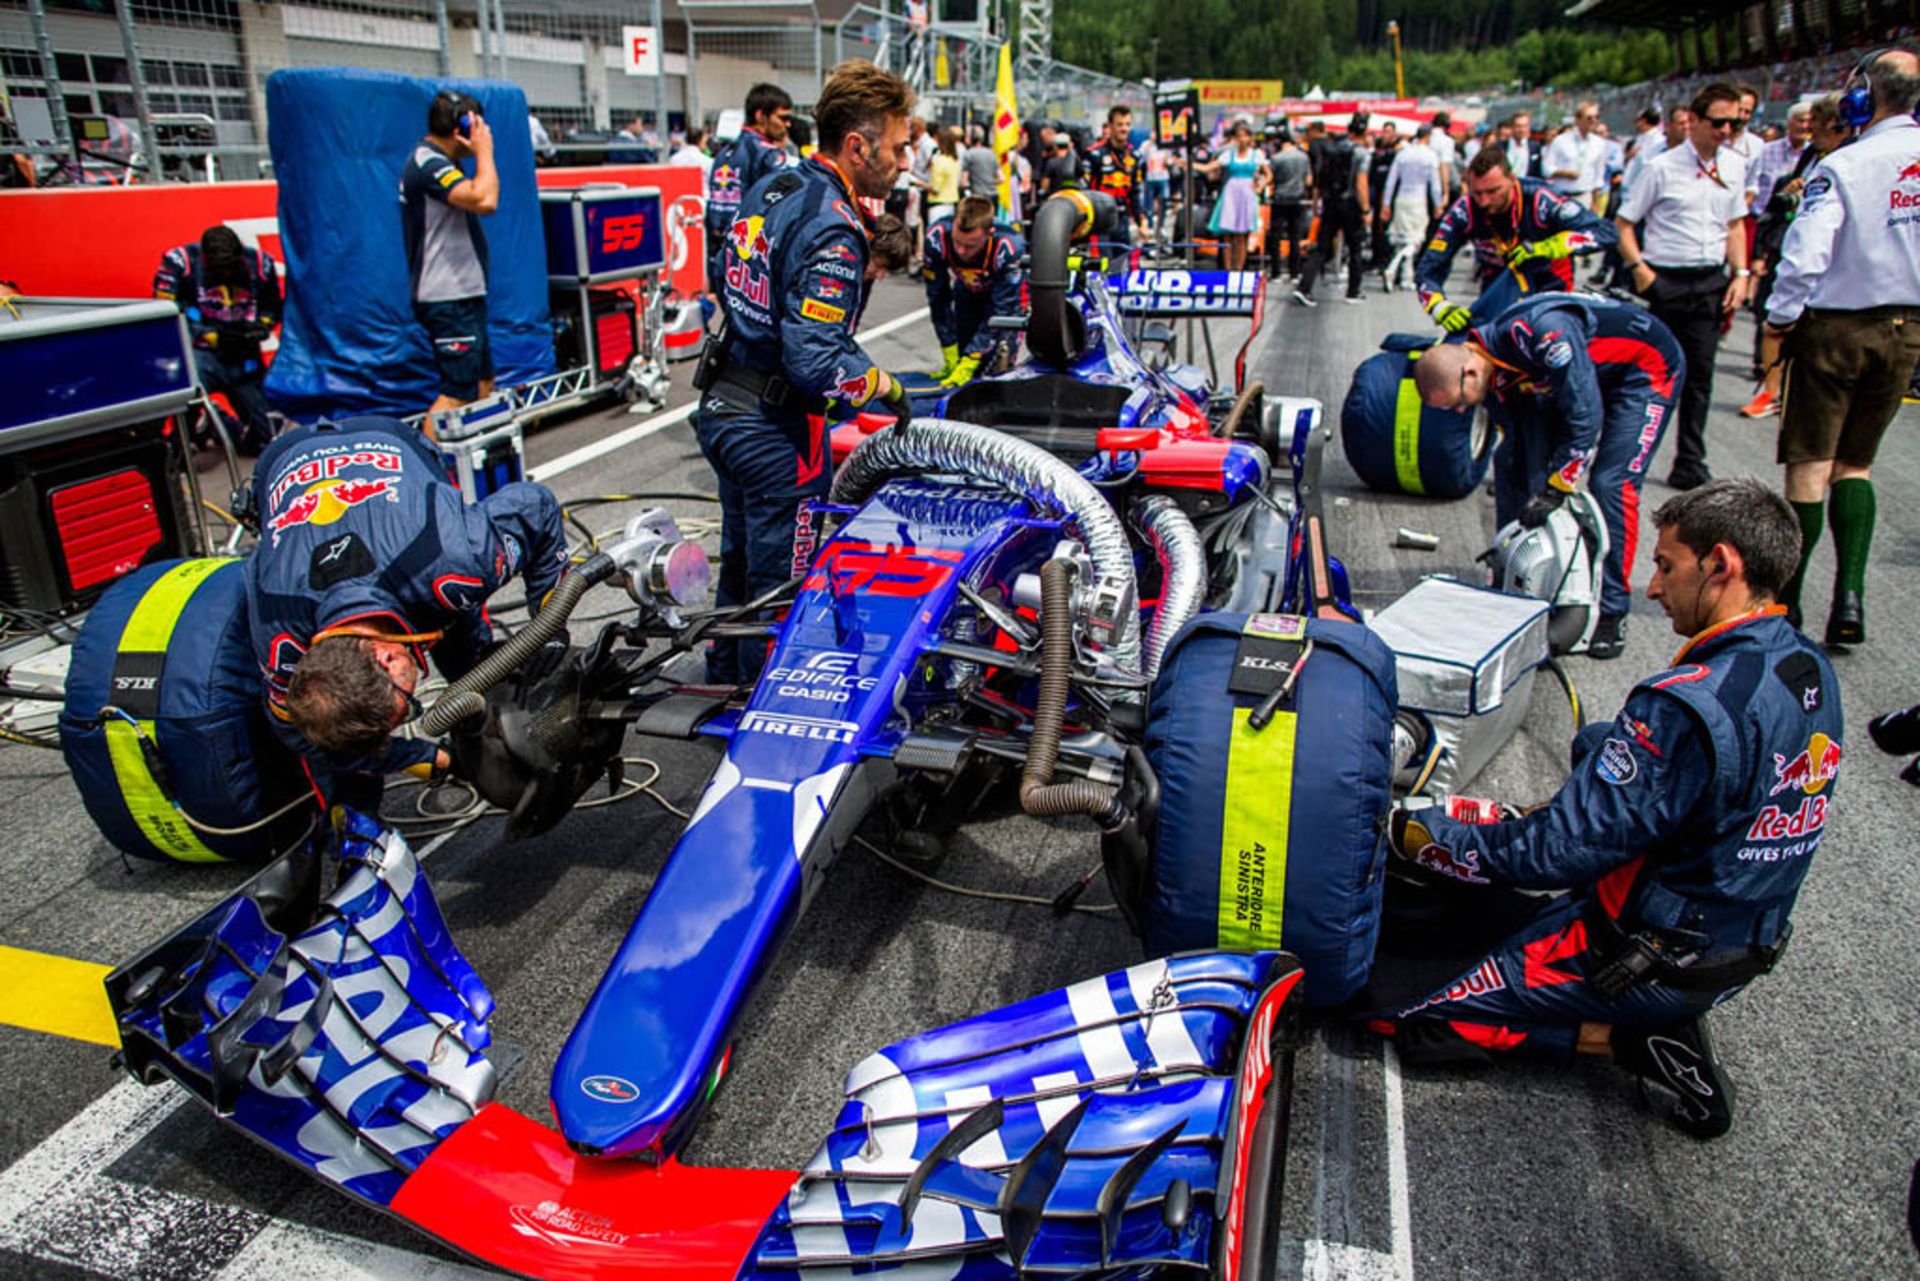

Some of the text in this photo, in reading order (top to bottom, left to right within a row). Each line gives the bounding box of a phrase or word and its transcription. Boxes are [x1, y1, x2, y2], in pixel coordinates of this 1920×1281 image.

[632, 37, 648, 65] F
[602, 213, 644, 254] 55
[269, 451, 404, 517] Red Bull
[766, 667, 880, 691] EDIFICE
[778, 685, 851, 703] CASIO
[738, 711, 860, 744] PIRELLI
[1745, 797, 1812, 841] Red
[1736, 846, 1780, 861] GIVES
[1235, 849, 1252, 922] SINISTRA
[1249, 841, 1267, 932] ANTERIORE
